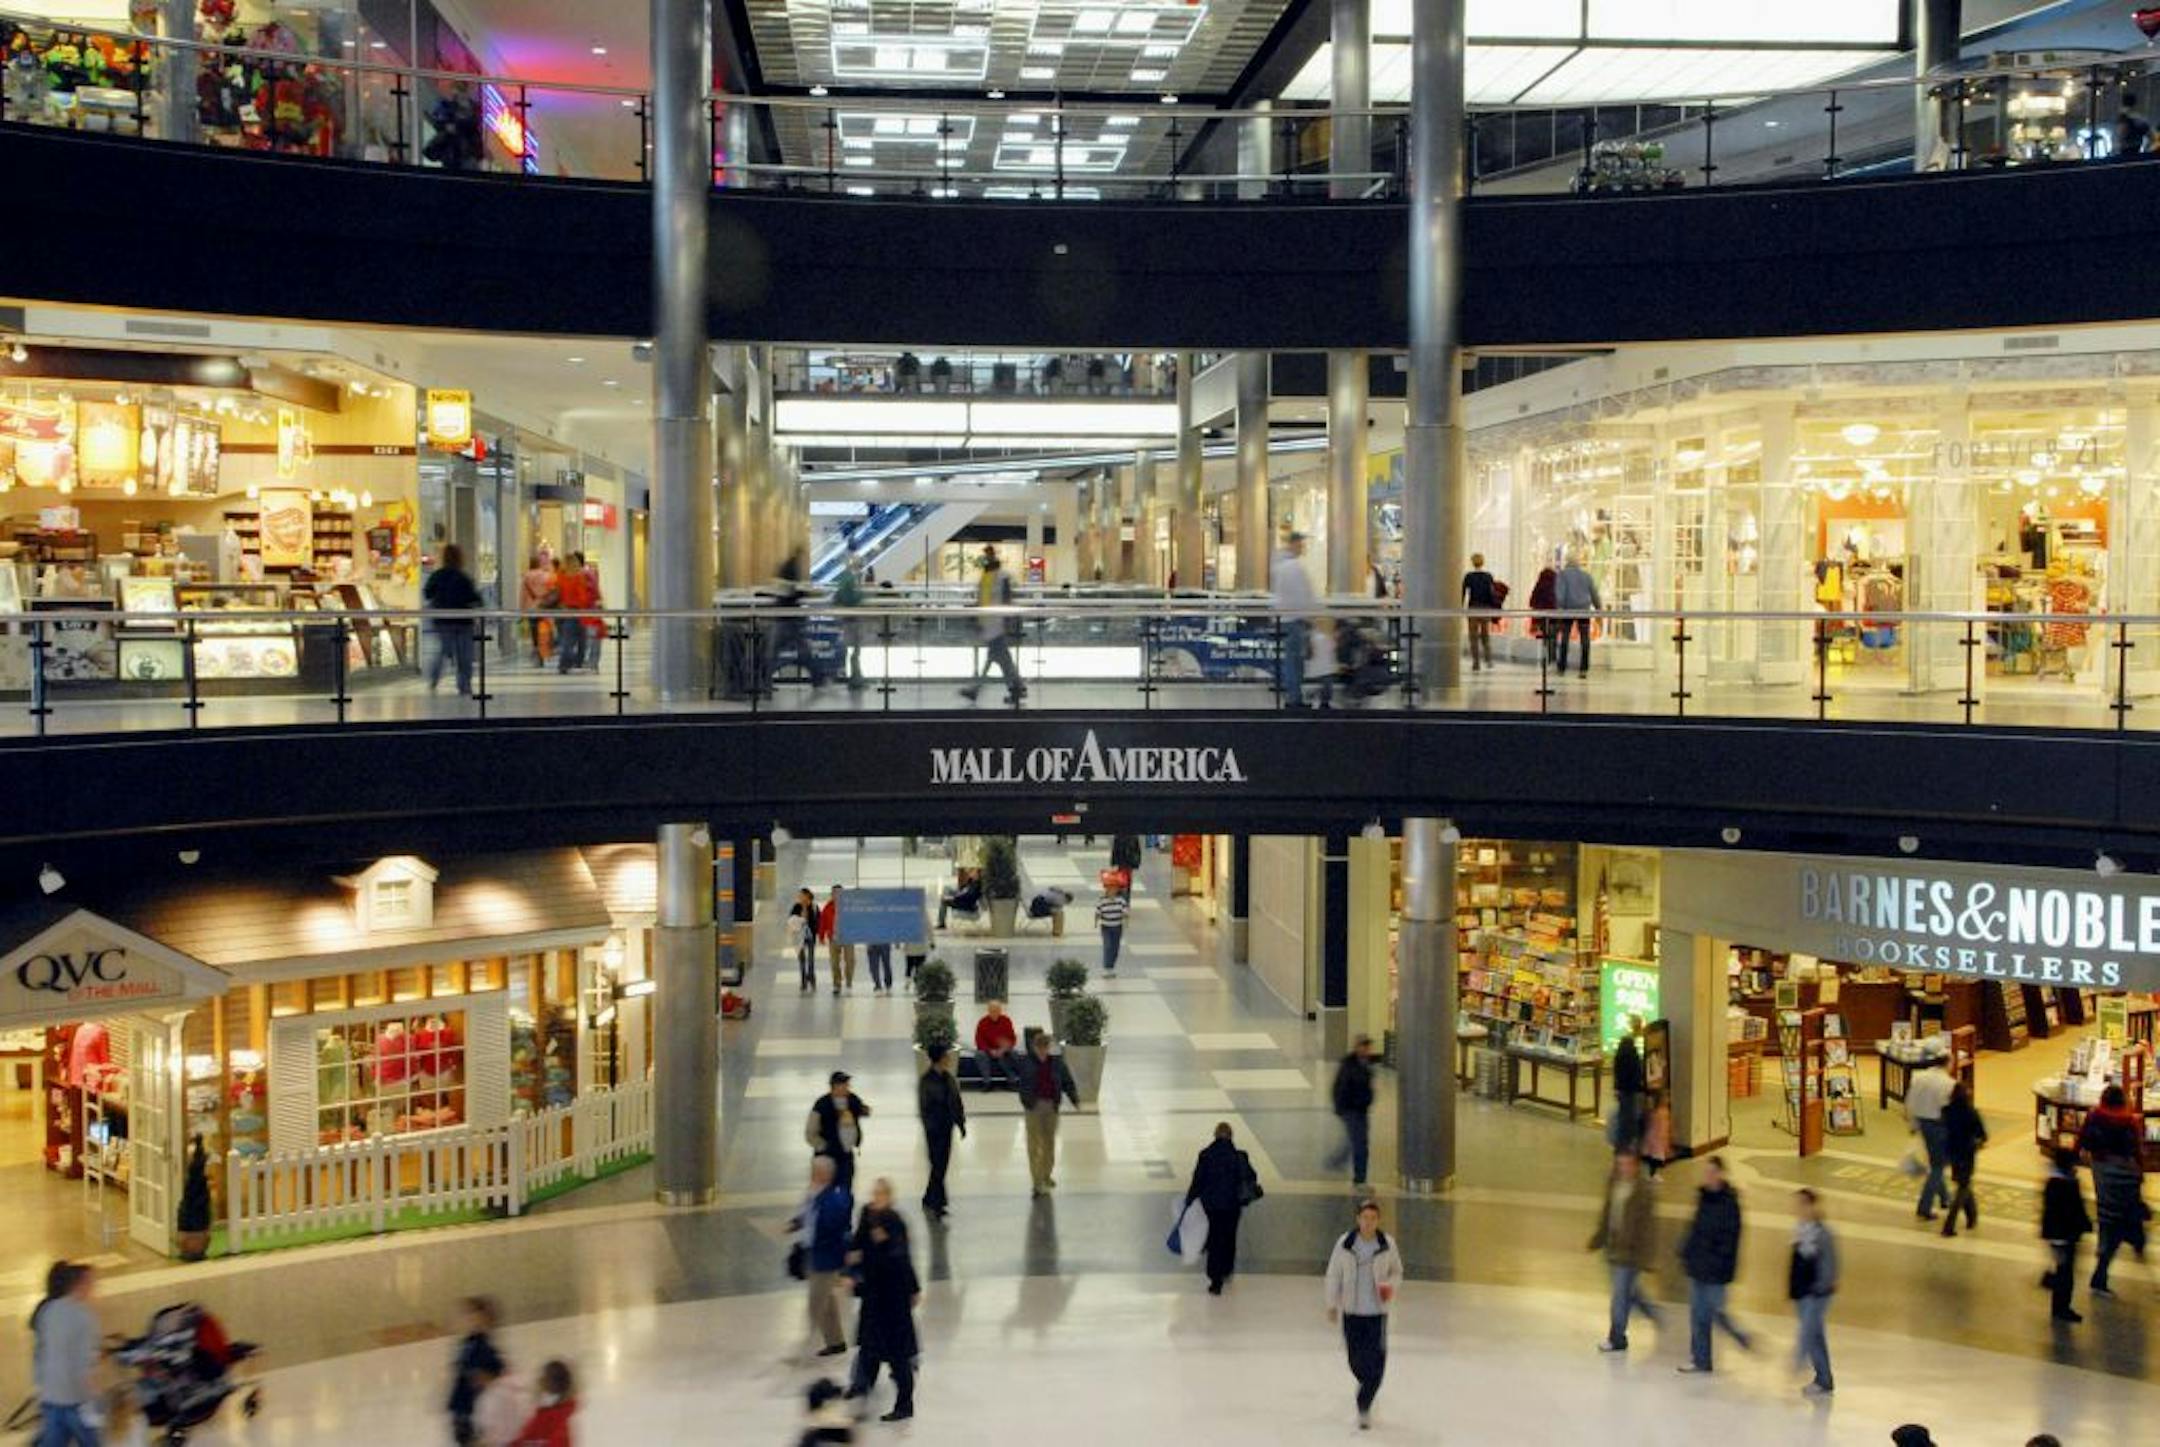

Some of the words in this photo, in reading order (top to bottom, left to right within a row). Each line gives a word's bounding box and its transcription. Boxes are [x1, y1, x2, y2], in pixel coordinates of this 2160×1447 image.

[1932, 438, 2058, 468] FOREVER
[2075, 436, 2099, 465] 21
[930, 748, 1025, 783] MALL
[1026, 748, 1075, 782] OF
[1070, 729, 1248, 782] AMERICA
[17, 947, 127, 992] QVC
[1612, 969, 1658, 990] OPEN
[1836, 936, 2121, 986] BOOKSELLERS
